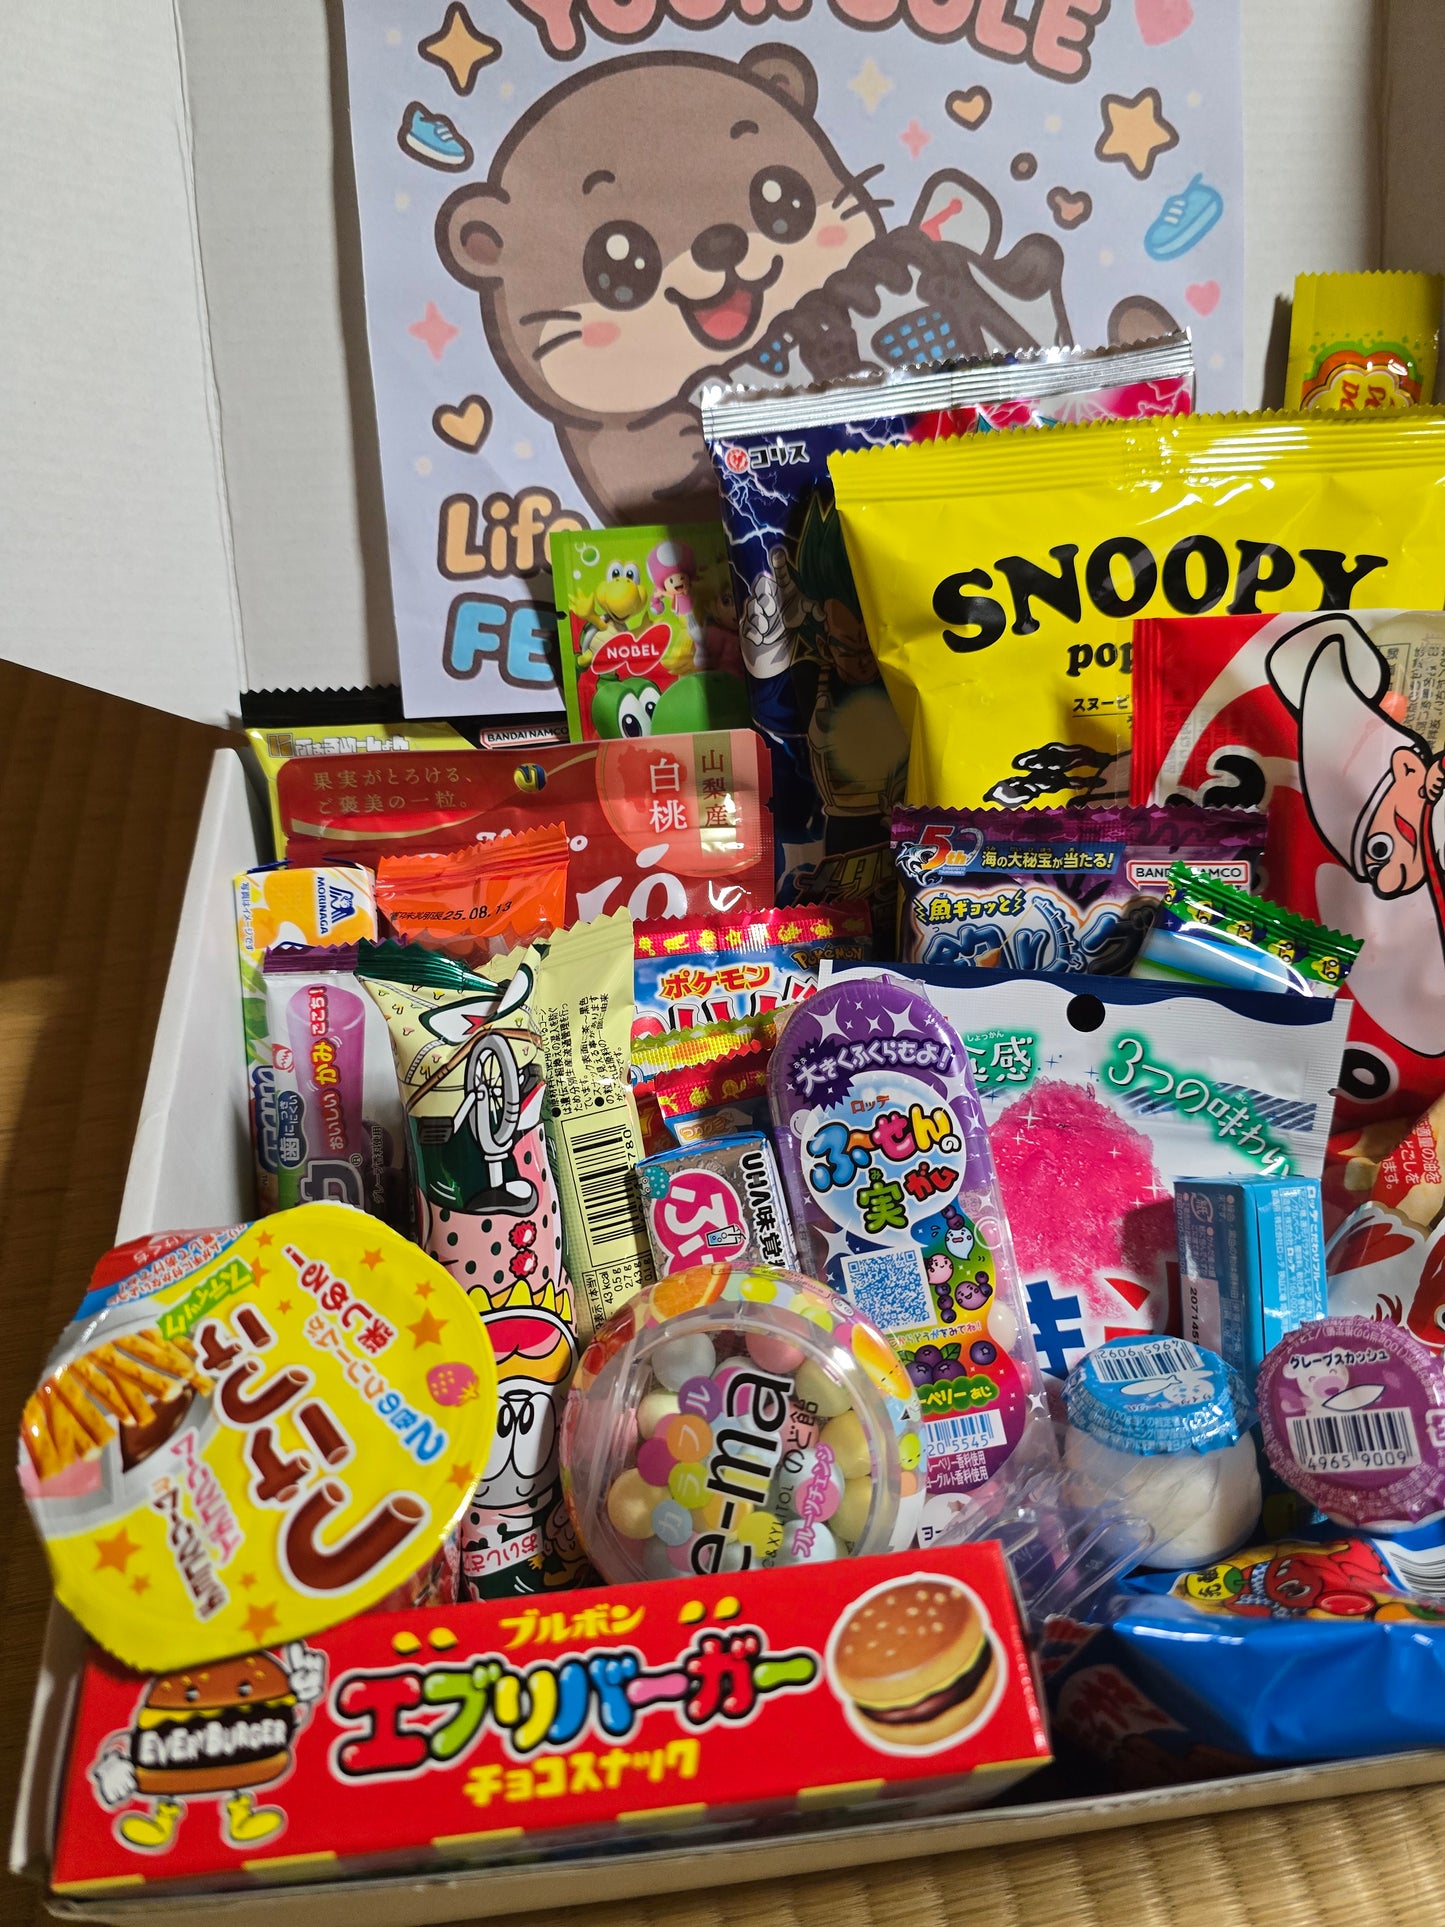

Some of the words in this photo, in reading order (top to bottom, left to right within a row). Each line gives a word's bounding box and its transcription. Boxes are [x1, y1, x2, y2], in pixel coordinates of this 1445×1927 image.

[750, 442, 808, 468] コリス
[932, 534, 1388, 653] SNOOPY
[606, 643, 660, 660] NOBEL
[487, 727, 528, 743] BANDAI
[314, 767, 472, 791] 果実がとろける、
[649, 757, 688, 834] 白桃
[701, 749, 735, 827] 山梨産
[318, 790, 469, 816] ご褒美の一粒。
[981, 850, 1115, 870] 海の大秘宝が当たる!
[316, 876, 329, 935] MORINAGA
[443, 901, 512, 921] 25.08.13
[928, 896, 1012, 921] 魚ギョッと
[661, 965, 770, 1000] ポケモン
[795, 1039, 953, 1100] 大きくふくらむよ!
[850, 1095, 890, 1115] ロッテ
[161, 1264, 253, 1337] スティック
[285, 1246, 396, 1353] 楽しめる!
[1190, 1288, 1201, 1346] 2071451
[1289, 1349, 1389, 1370] グレープスカッシュ
[783, 1398, 819, 1474] のど飴
[952, 1434, 990, 1453] 5545
[691, 1372, 794, 1575] e-ma
[1308, 1457, 1350, 1471] 4965
[1361, 1452, 1408, 1467] 9009
[792, 1443, 834, 1557] フルーツチェンジ
[501, 1604, 645, 1648] ブルボン
[336, 1630, 820, 1778] エブリバーガー
[463, 1740, 701, 1807] チョコスナック
